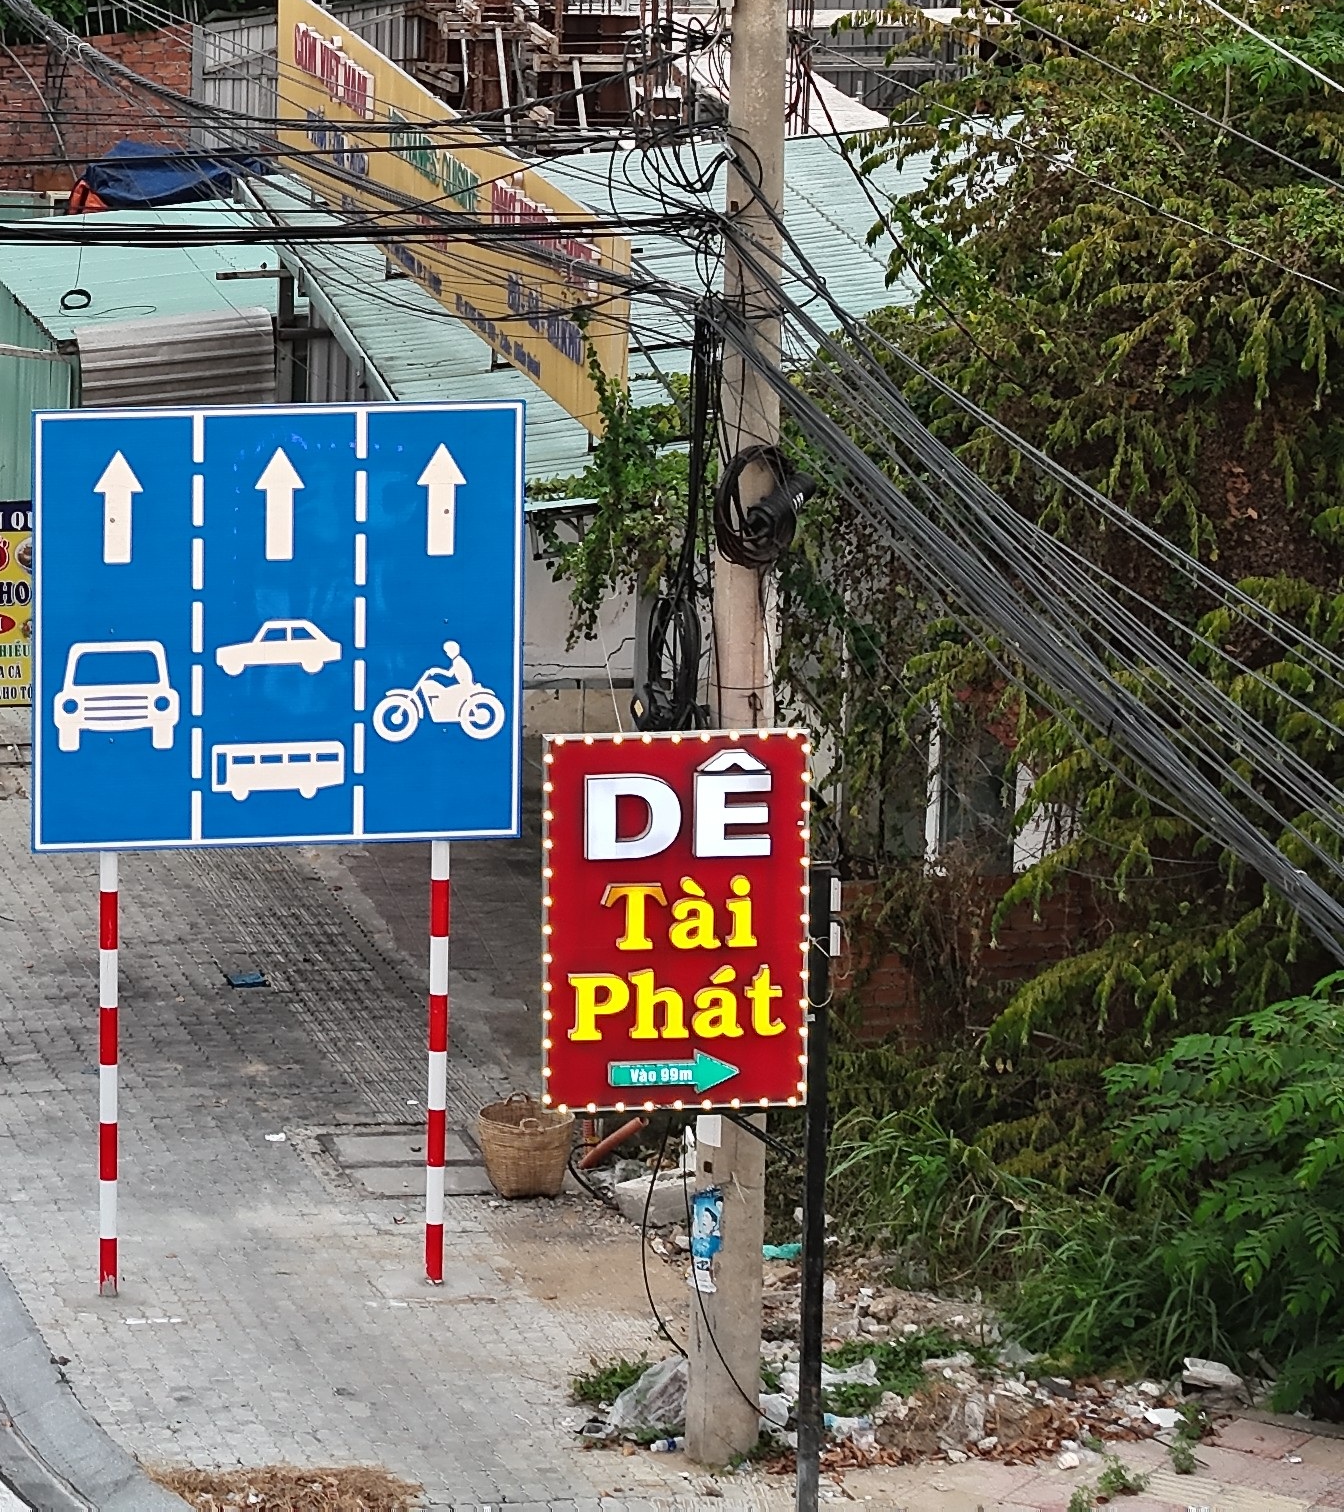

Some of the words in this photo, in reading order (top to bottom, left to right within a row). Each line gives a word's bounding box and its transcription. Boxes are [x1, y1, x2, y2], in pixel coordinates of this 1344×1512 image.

[584, 748, 772, 860] DÊ
[600, 875, 758, 951] Tài
[567, 964, 787, 1041] Phát
[630, 1067, 656, 1083] Vào
[660, 1069, 693, 1082] 99m
